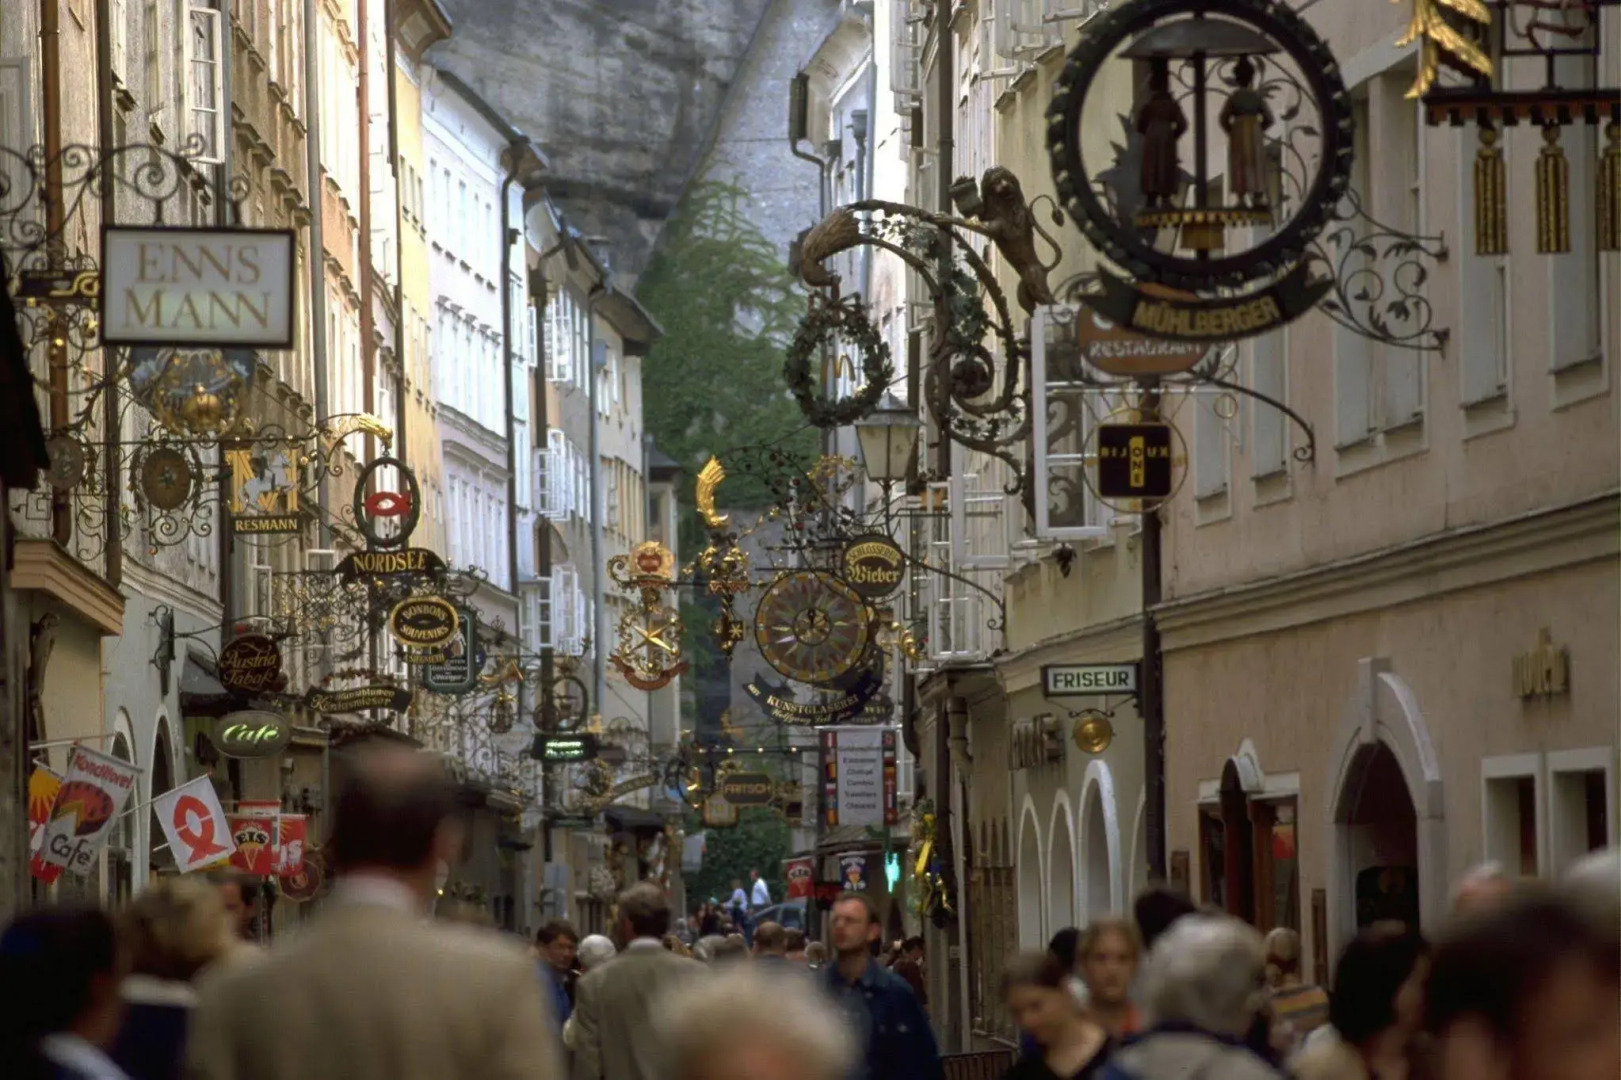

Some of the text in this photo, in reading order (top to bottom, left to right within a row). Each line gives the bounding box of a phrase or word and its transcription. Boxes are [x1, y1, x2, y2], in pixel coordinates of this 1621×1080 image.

[136, 242, 262, 284] ENNS
[122, 288, 271, 330] MANN
[1132, 294, 1280, 334] MÜHLBERGER
[1089, 339, 1202, 357] RESTAURANT
[1100, 446, 1169, 458] BIJOUX
[235, 518, 299, 532] RESMANN
[352, 548, 427, 574] NORDSEE
[846, 564, 899, 584] Wieber
[402, 604, 448, 621] BONBONS
[400, 624, 449, 640] SOUVENIRS
[221, 643, 278, 670] Austria
[223, 668, 275, 690] Tabak
[1052, 671, 1130, 690] FRISEUR
[766, 694, 860, 715] KUNSTGLASEREI
[222, 722, 280, 744] Café
[73, 751, 134, 789] Konditorei
[724, 783, 772, 795] FRITSCH
[235, 831, 268, 845] EIS
[50, 833, 94, 868] Café
